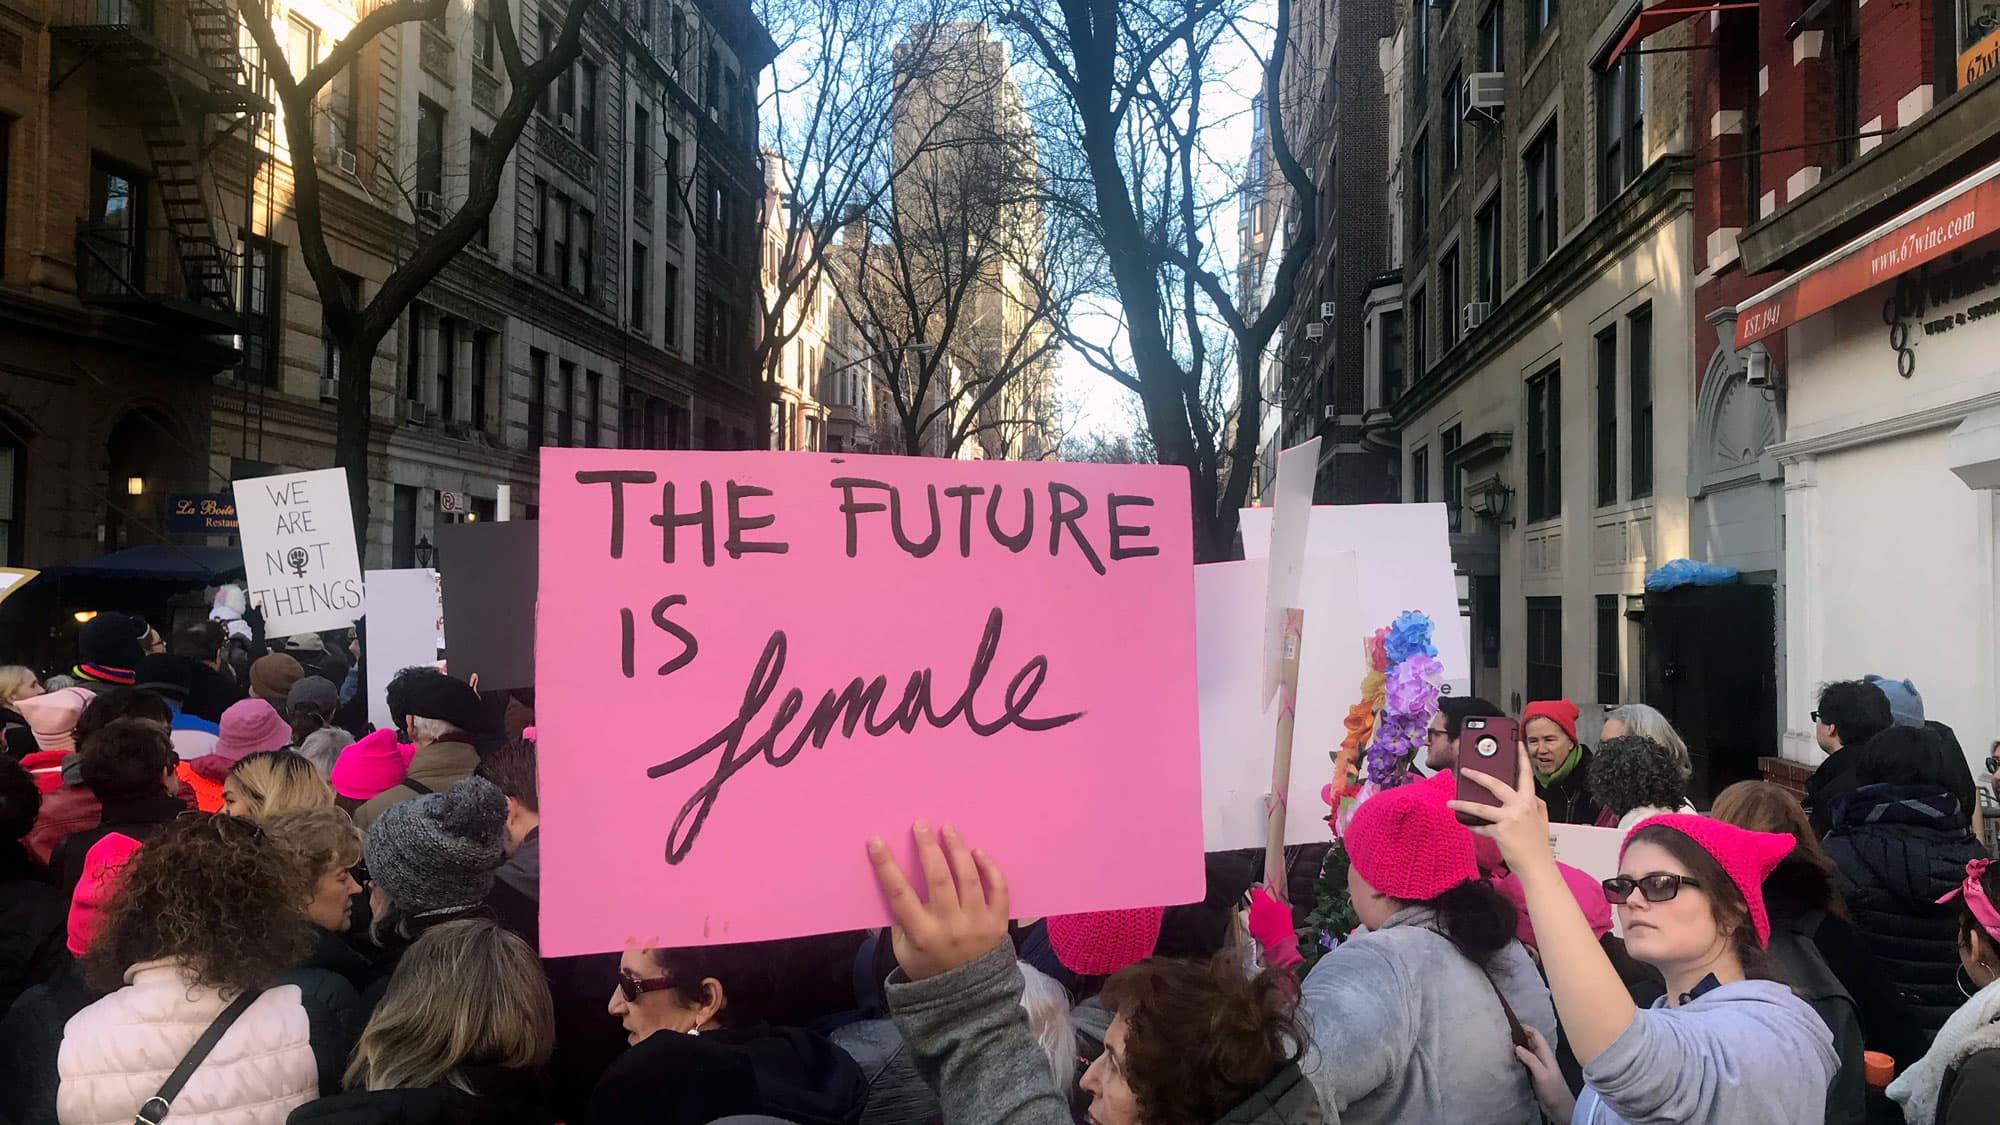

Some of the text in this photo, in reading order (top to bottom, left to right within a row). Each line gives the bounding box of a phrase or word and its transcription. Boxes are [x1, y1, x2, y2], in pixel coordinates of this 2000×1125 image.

[1871, 210, 1975, 276] www.67wine.com
[1743, 303, 1780, 339] EST. 1941
[176, 499, 196, 515] La
[265, 480, 309, 507] WE
[276, 510, 316, 535] ARE
[575, 470, 1160, 577] THE FUTURE
[265, 542, 330, 578] NOT
[252, 579, 361, 618] THINGS
[620, 594, 699, 679] IS
[646, 606, 1088, 866] female
